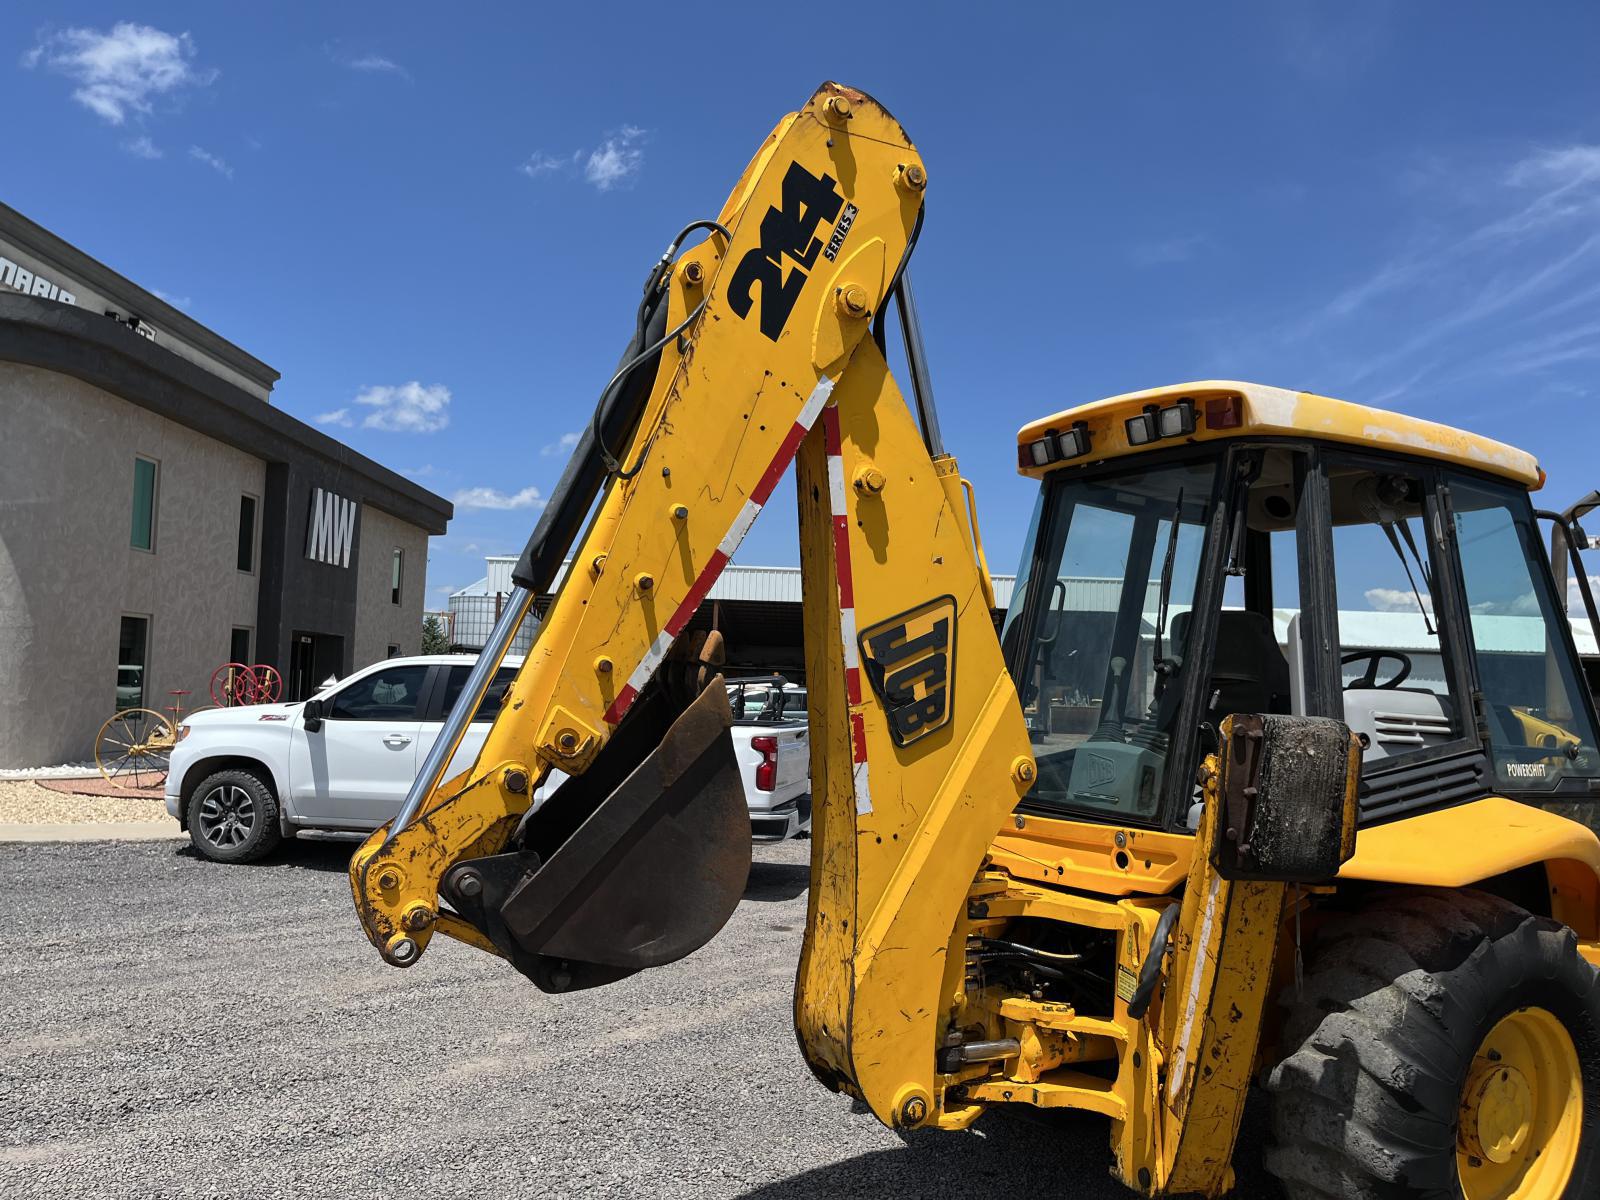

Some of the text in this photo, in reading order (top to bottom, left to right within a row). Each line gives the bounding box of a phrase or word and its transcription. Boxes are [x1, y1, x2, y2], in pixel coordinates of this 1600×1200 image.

[727, 160, 845, 343] 214
[824, 202, 858, 262] SERIES 3
[308, 487, 357, 569] MW
[869, 616, 949, 736] JCB
[1506, 763, 1546, 777] POWERSHIFT
